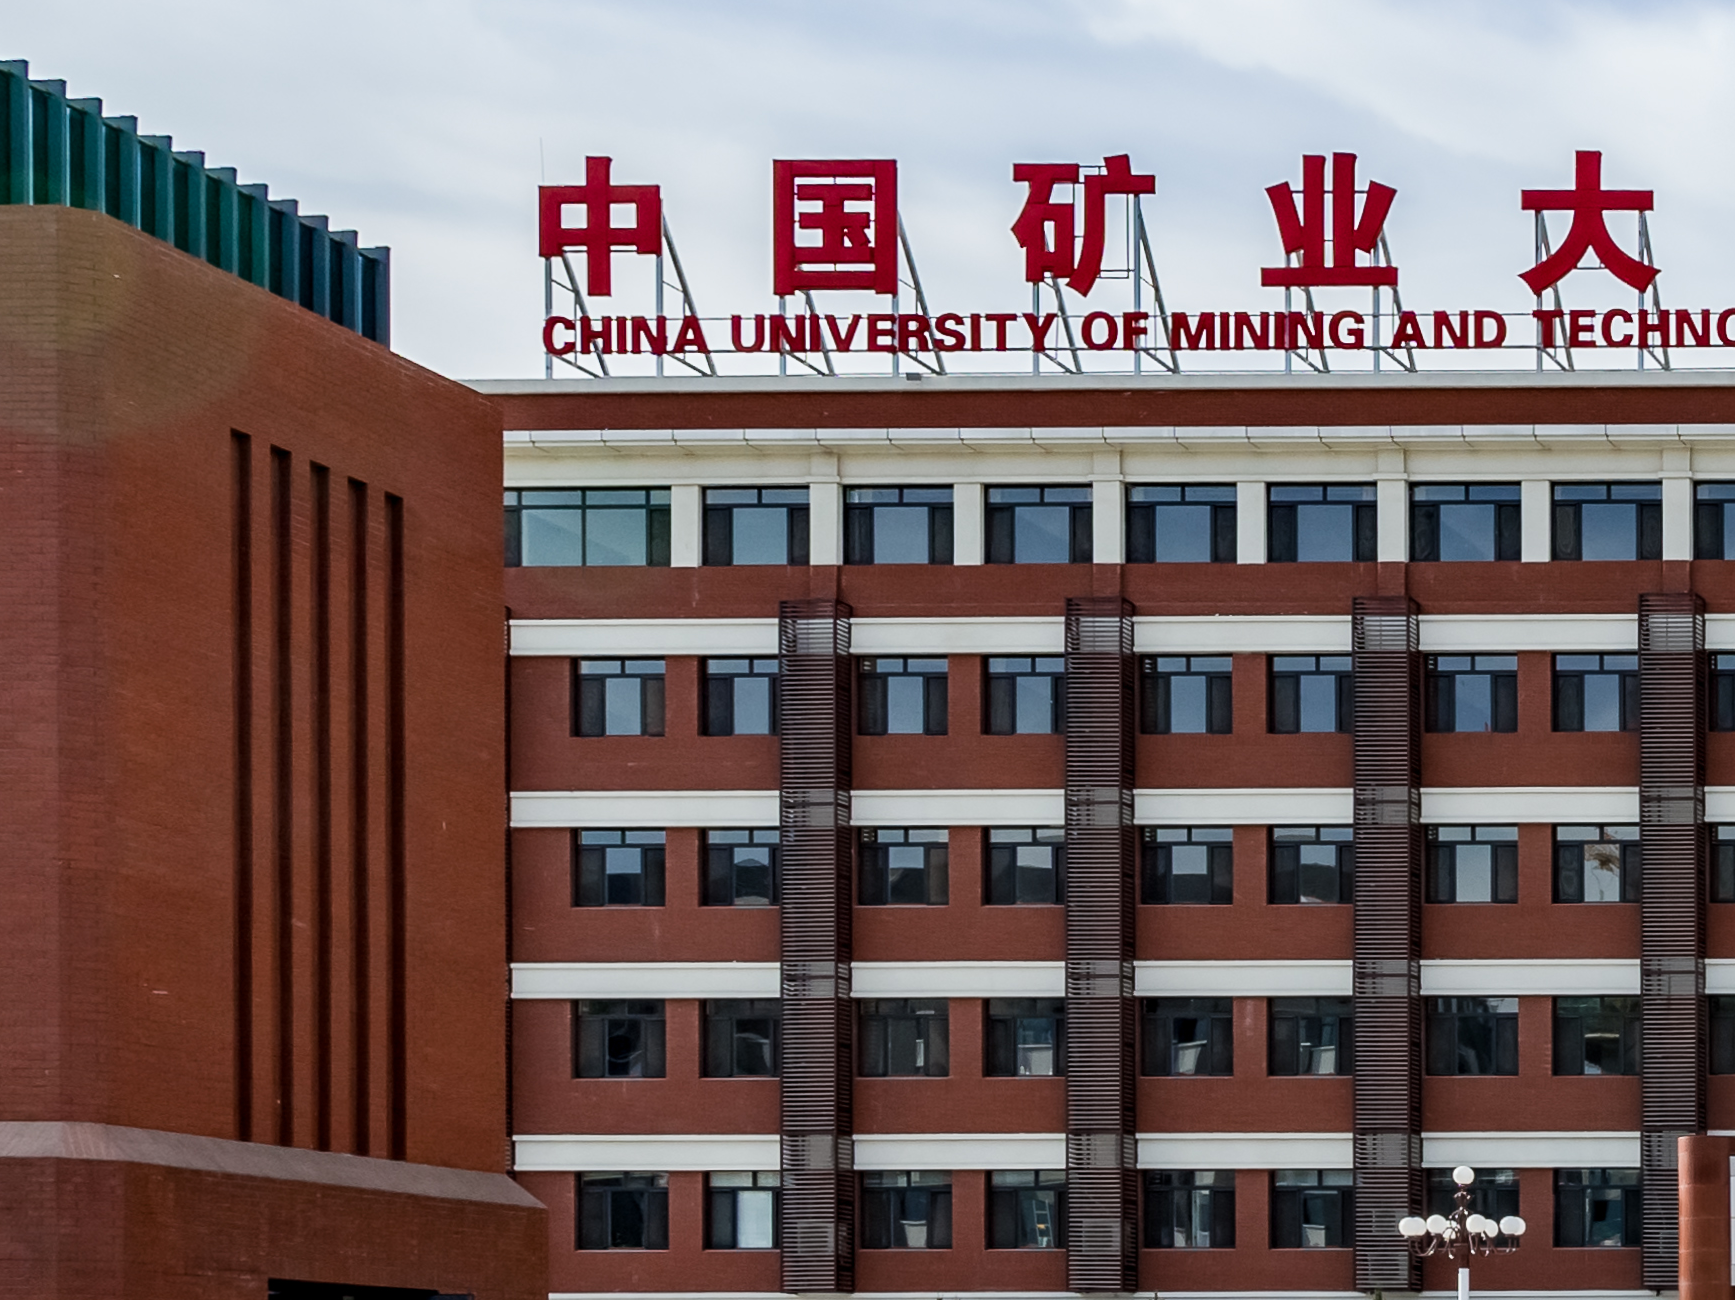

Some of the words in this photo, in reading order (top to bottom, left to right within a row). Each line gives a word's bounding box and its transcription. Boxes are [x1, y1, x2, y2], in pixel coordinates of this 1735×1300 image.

[542, 315, 709, 356] CHINA
[731, 312, 1056, 354] UNIVERSITY
[1081, 311, 1149, 351] OF
[1169, 310, 1365, 351] MINING
[1391, 310, 1507, 349] AND
